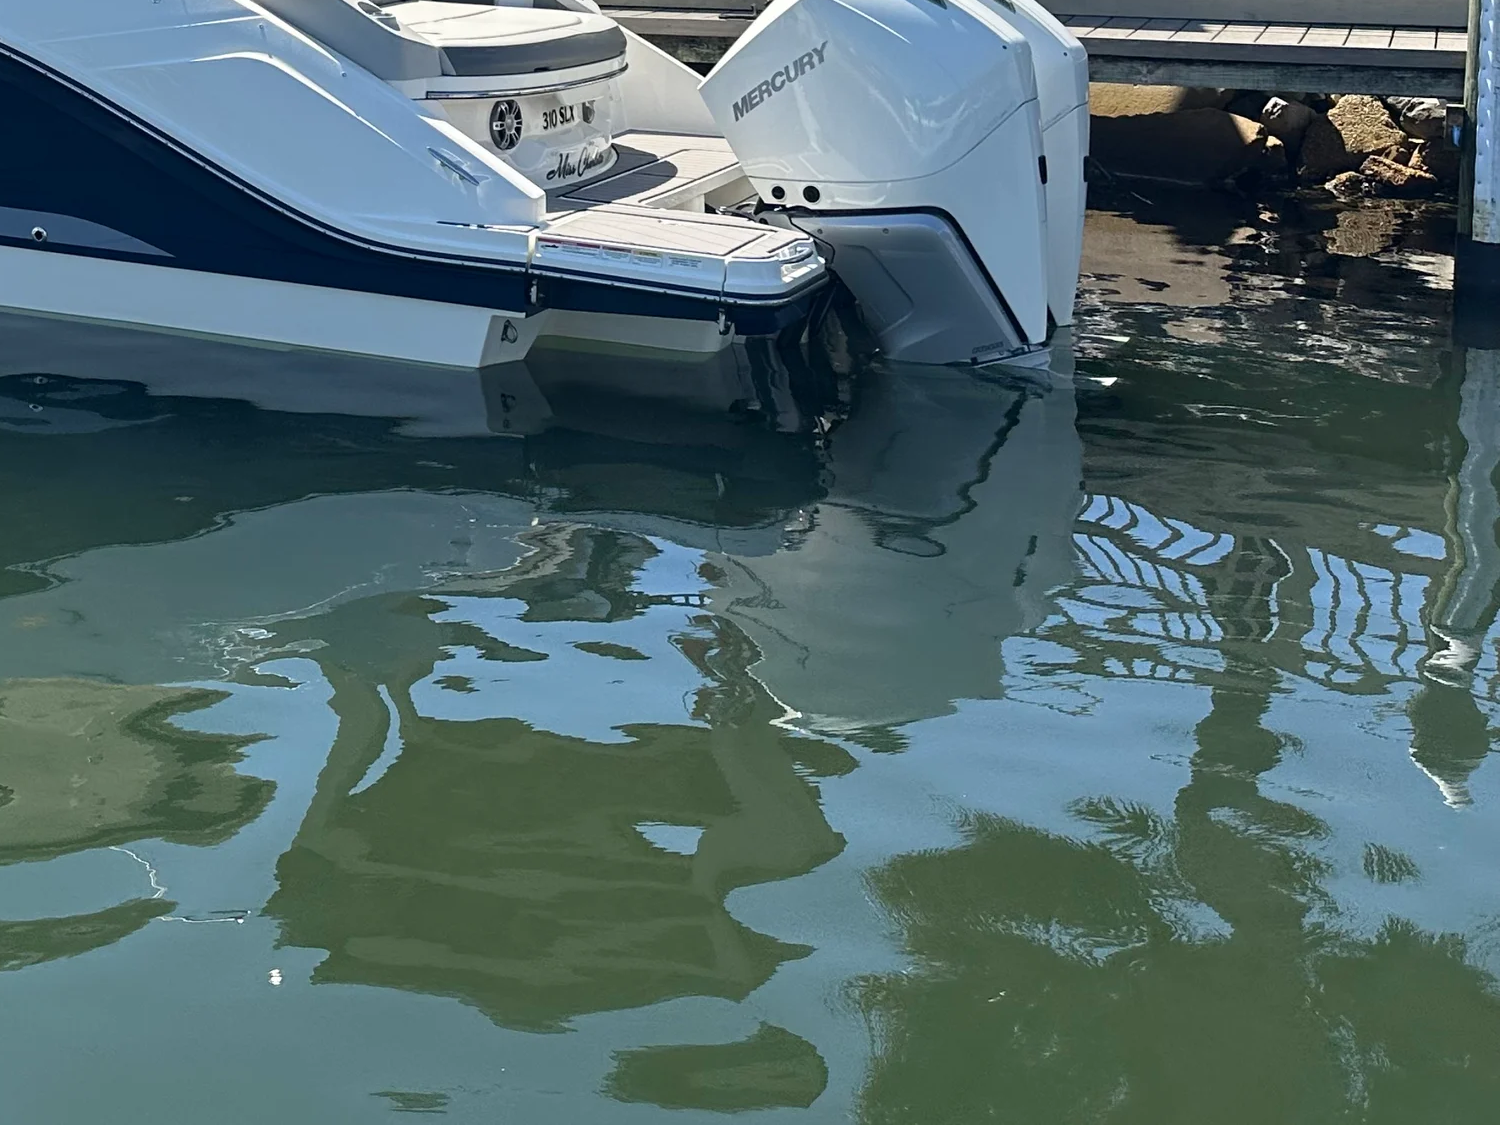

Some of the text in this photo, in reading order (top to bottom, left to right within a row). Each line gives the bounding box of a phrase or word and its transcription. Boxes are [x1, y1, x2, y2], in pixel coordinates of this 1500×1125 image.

[732, 40, 828, 122] MERCURY
[542, 104, 575, 131] 310 SLX
